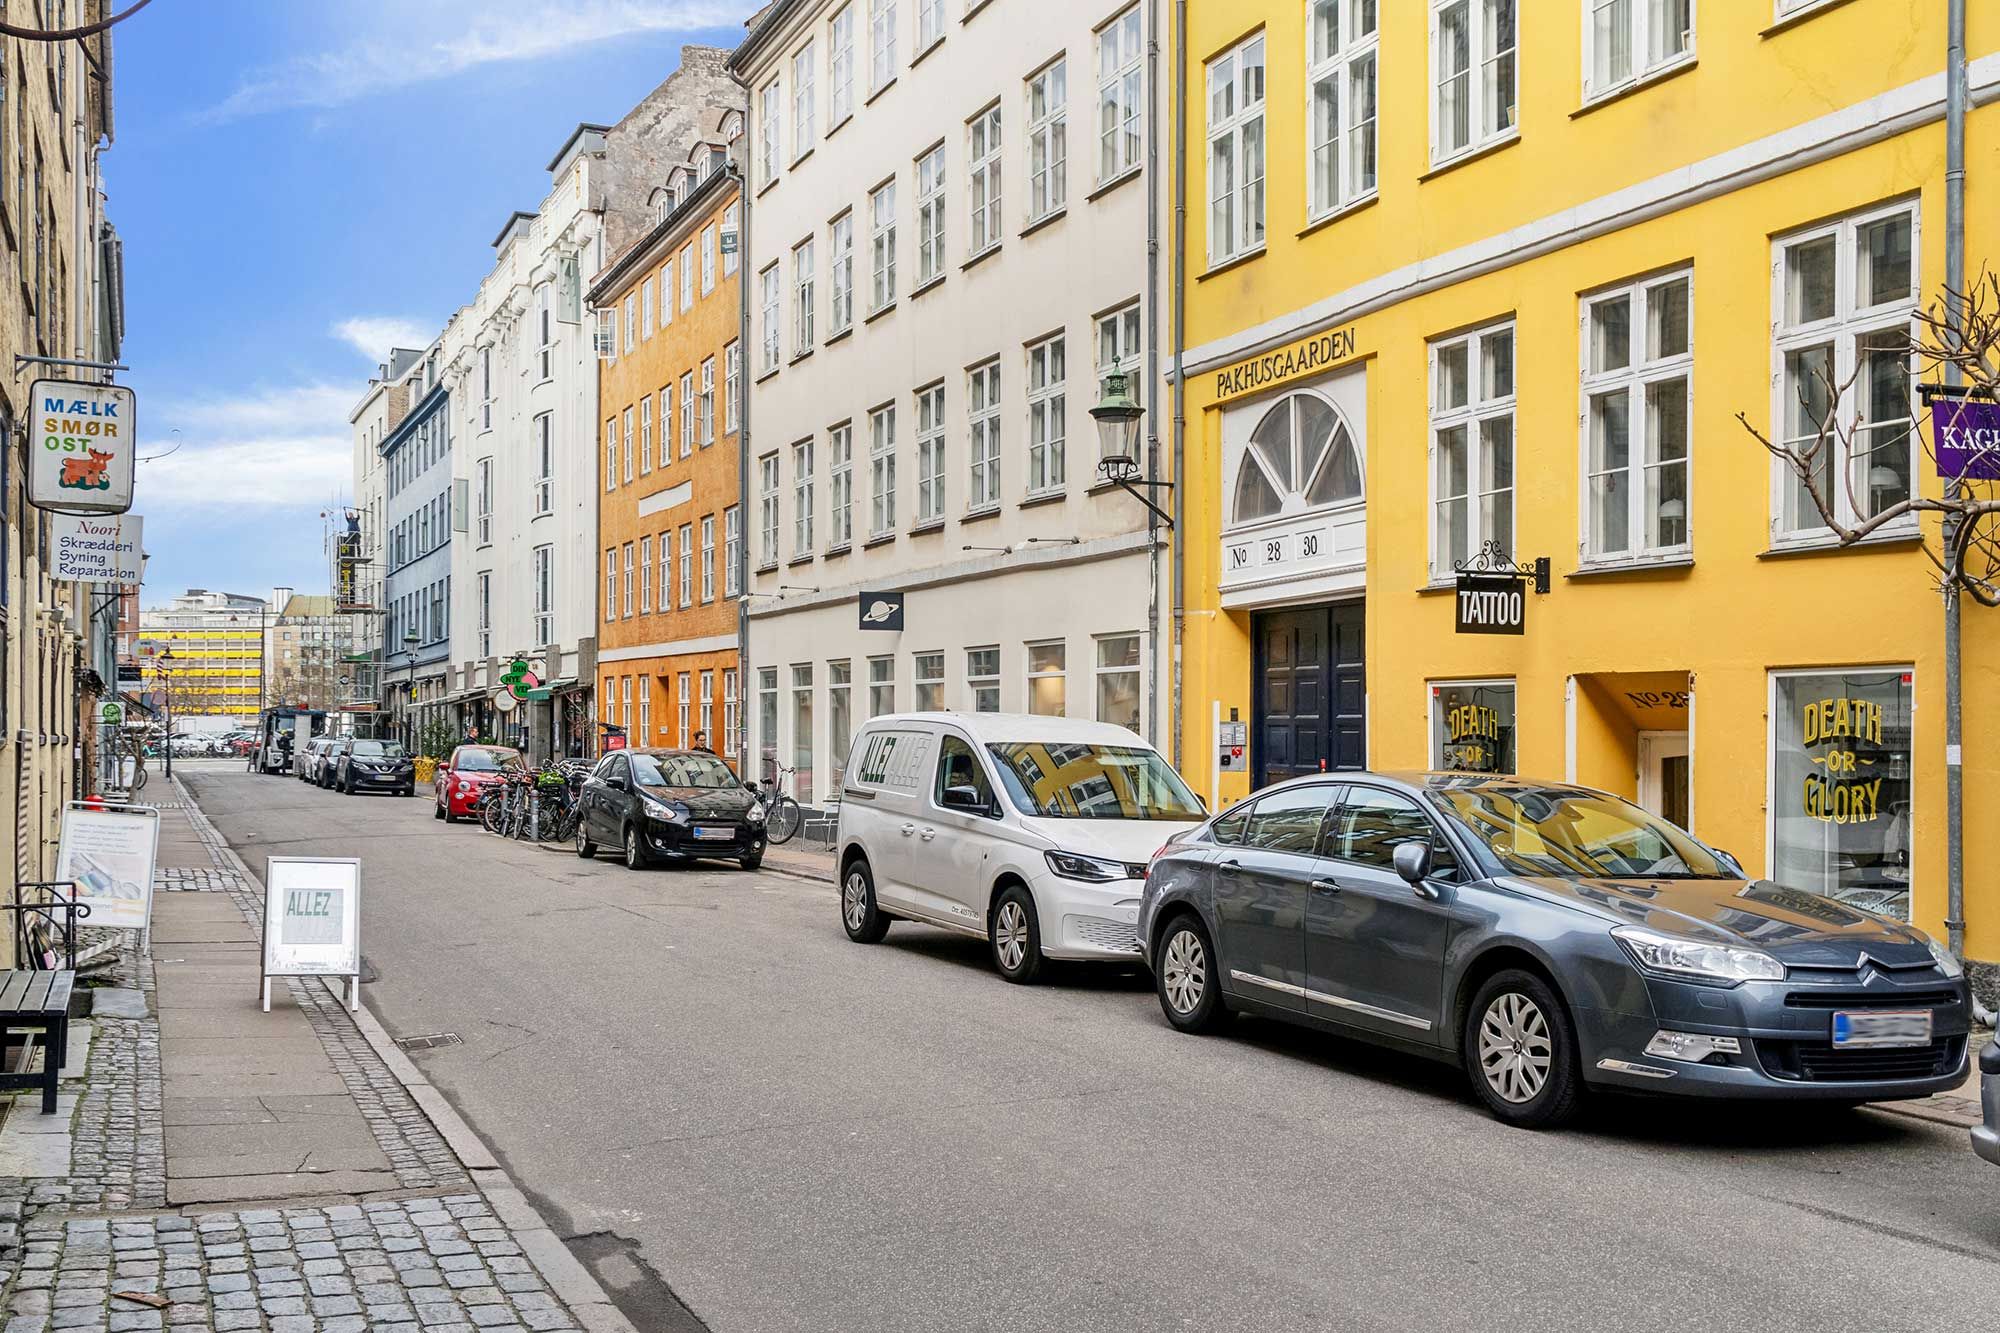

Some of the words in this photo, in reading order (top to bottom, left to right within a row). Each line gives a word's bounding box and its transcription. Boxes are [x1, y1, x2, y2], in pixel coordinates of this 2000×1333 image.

[1217, 327, 1355, 398] PAKHUSGAARDEN
[44, 398, 118, 418] MÆLK
[44, 418, 118, 438] SMØR
[44, 436, 92, 453] OST
[75, 520, 121, 537] Noori
[59, 536, 133, 553] Skrædderi
[1267, 541, 1281, 561] 28
[1303, 535, 1318, 556] 30
[59, 549, 106, 567] Syning
[59, 562, 136, 579] Reparation
[1459, 591, 1521, 626] TATTOO
[505, 675, 521, 683] NYE
[512, 665, 527, 673] DIN
[1451, 704, 1498, 742] DEATH
[1803, 698, 1883, 746] DEATH
[609, 738, 615, 746] P
[858, 735, 897, 784] ALLEZ
[1466, 745, 1483, 763] OR
[1826, 750, 1857, 772] OR
[1803, 777, 1883, 825] GLORY
[286, 891, 332, 917] ALLEZ
